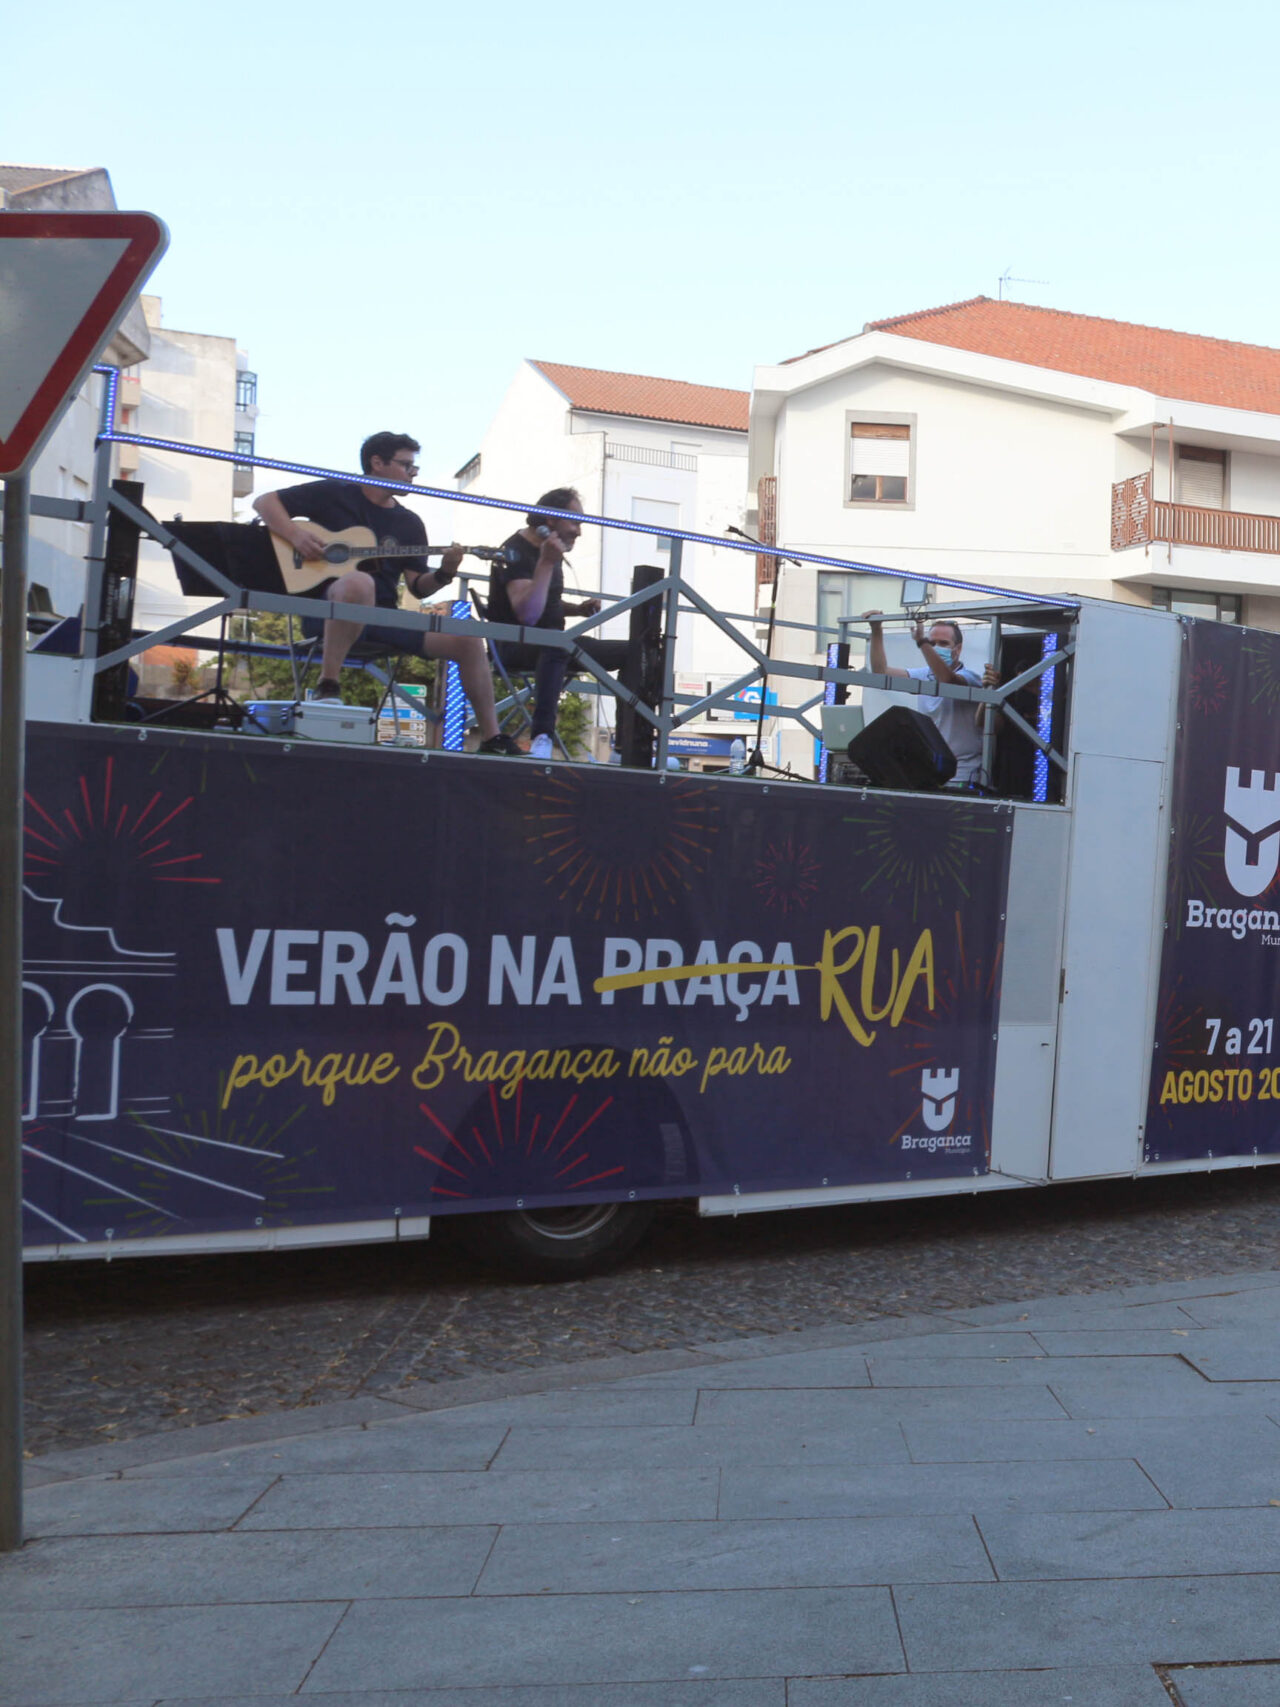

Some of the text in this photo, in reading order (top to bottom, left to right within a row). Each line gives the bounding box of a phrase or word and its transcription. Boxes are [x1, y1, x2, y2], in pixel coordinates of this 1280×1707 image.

[216, 912, 936, 1047] VERÃO NA PRAÇA RUA
[1205, 1017, 1274, 1056] 7 a 21
[221, 1021, 792, 1110] porque Bragança não para
[1159, 1067, 1254, 1105] AGOSTO
[901, 1135, 972, 1153] Bragança
